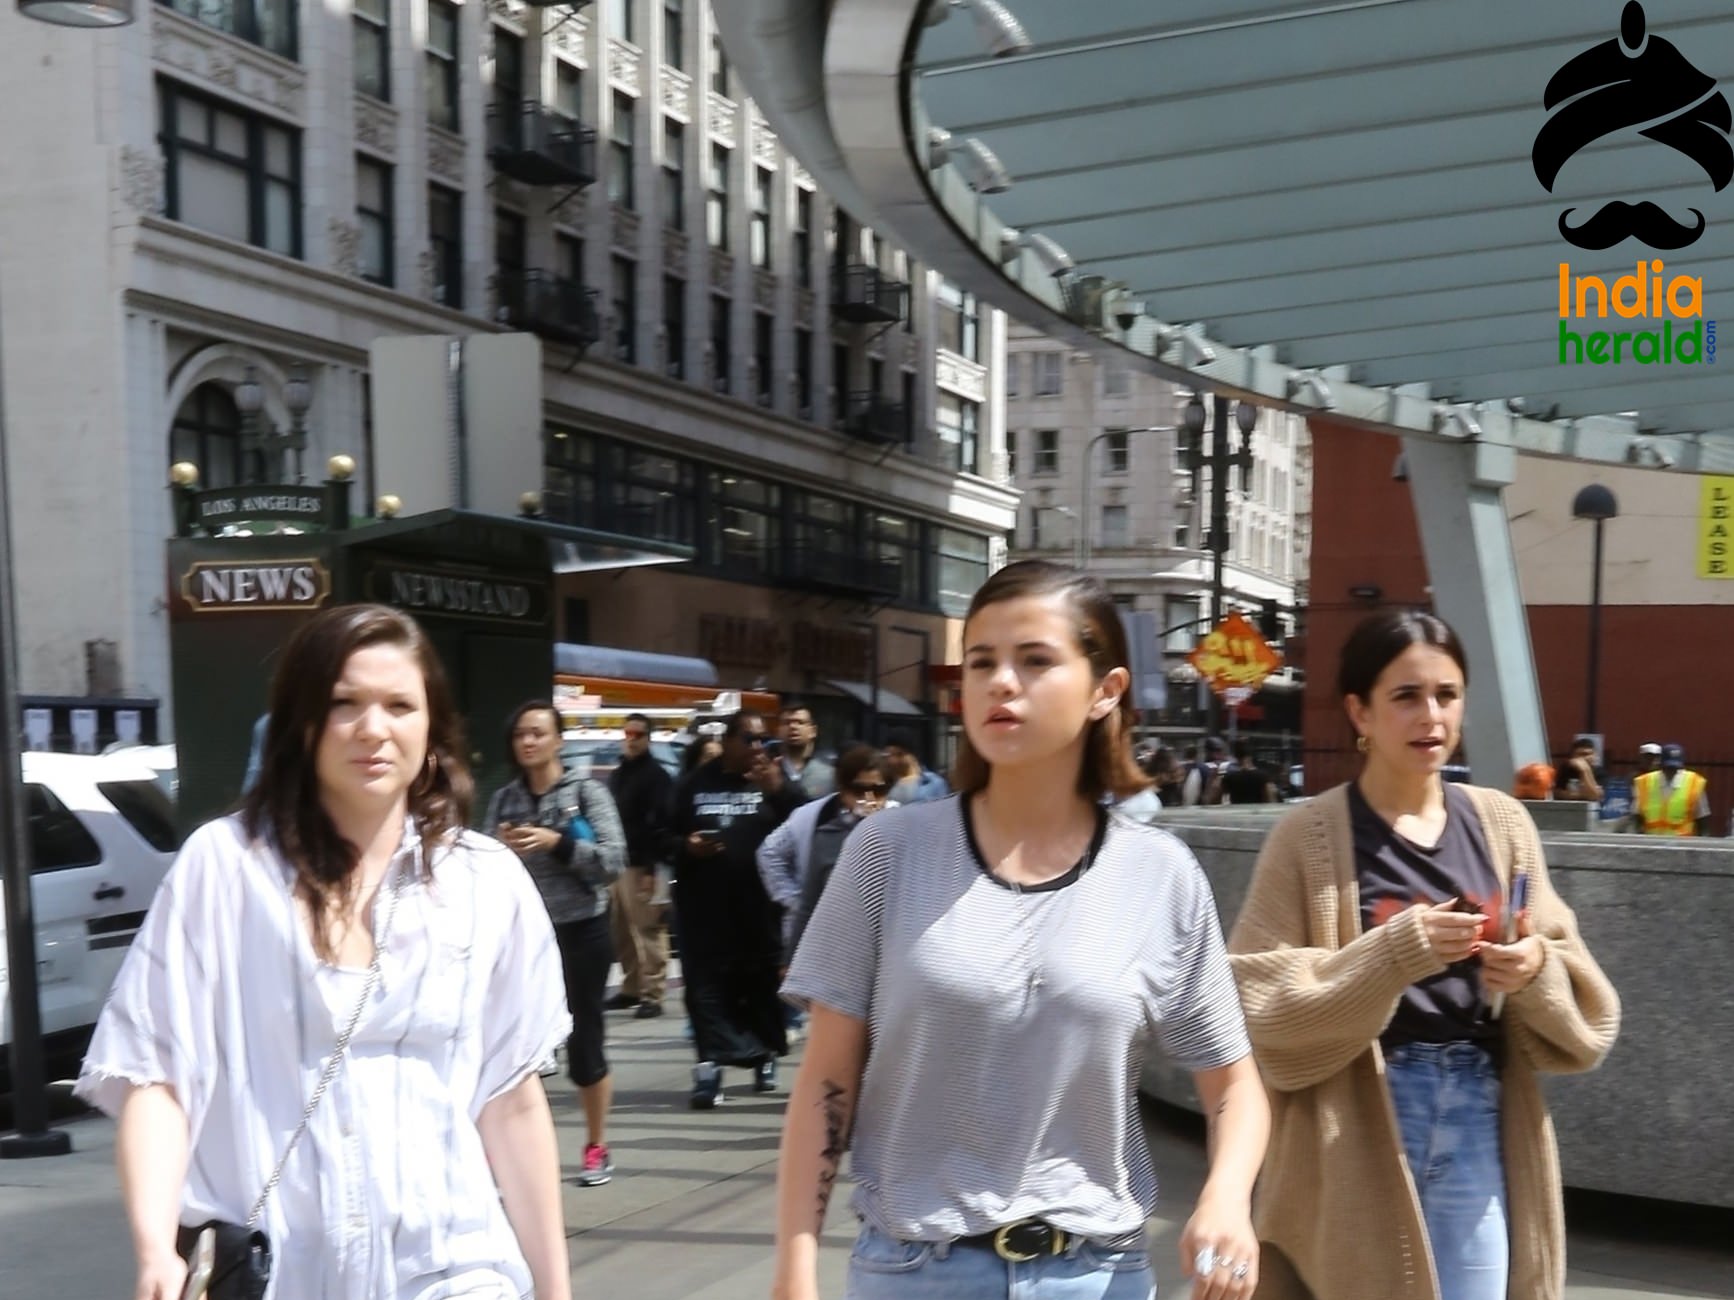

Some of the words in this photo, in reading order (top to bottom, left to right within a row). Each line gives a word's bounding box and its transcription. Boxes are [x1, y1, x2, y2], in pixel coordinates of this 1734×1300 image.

[240, 495, 322, 513] ANGELES
[1707, 487, 1731, 574] LEASE
[200, 566, 316, 603] NEWS
